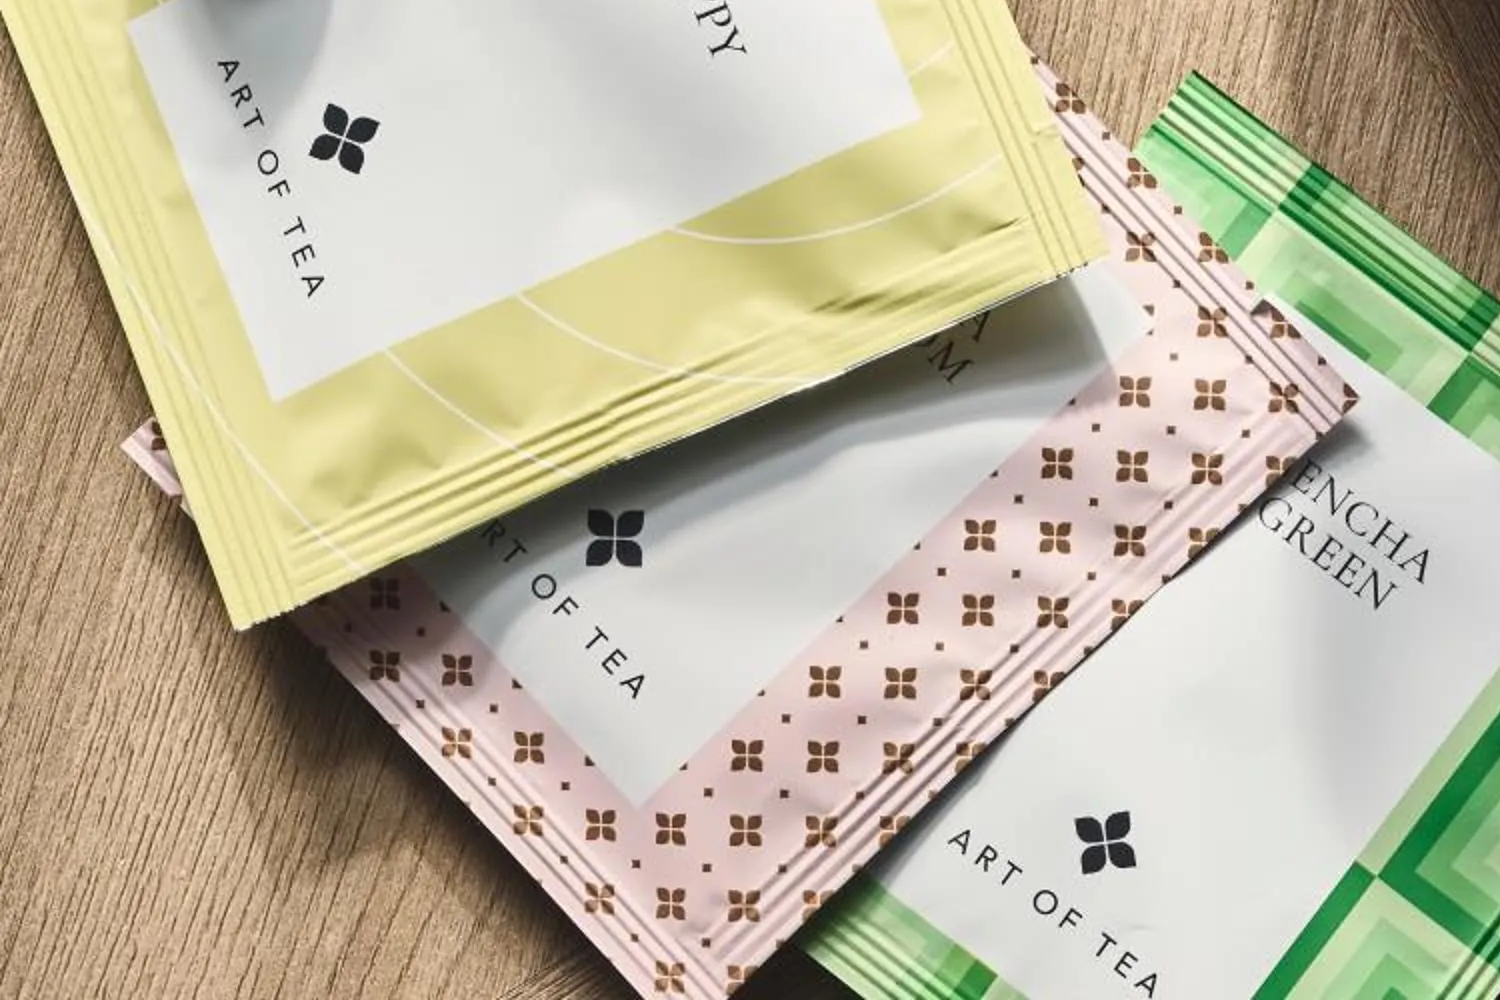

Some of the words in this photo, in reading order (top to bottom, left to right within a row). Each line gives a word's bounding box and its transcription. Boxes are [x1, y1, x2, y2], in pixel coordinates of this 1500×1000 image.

[217, 60, 265, 128] ART
[257, 149, 291, 198] OF
[283, 215, 325, 298] TEA
[1258, 496, 1398, 610] GREEN
[1291, 458, 1430, 584] ENCHA
[480, 518, 528, 563] RT
[531, 573, 579, 616] OF
[585, 625, 646, 699] TEA
[947, 828, 1023, 886] ART
[1032, 889, 1083, 928] OF
[1095, 932, 1159, 999] TEA
